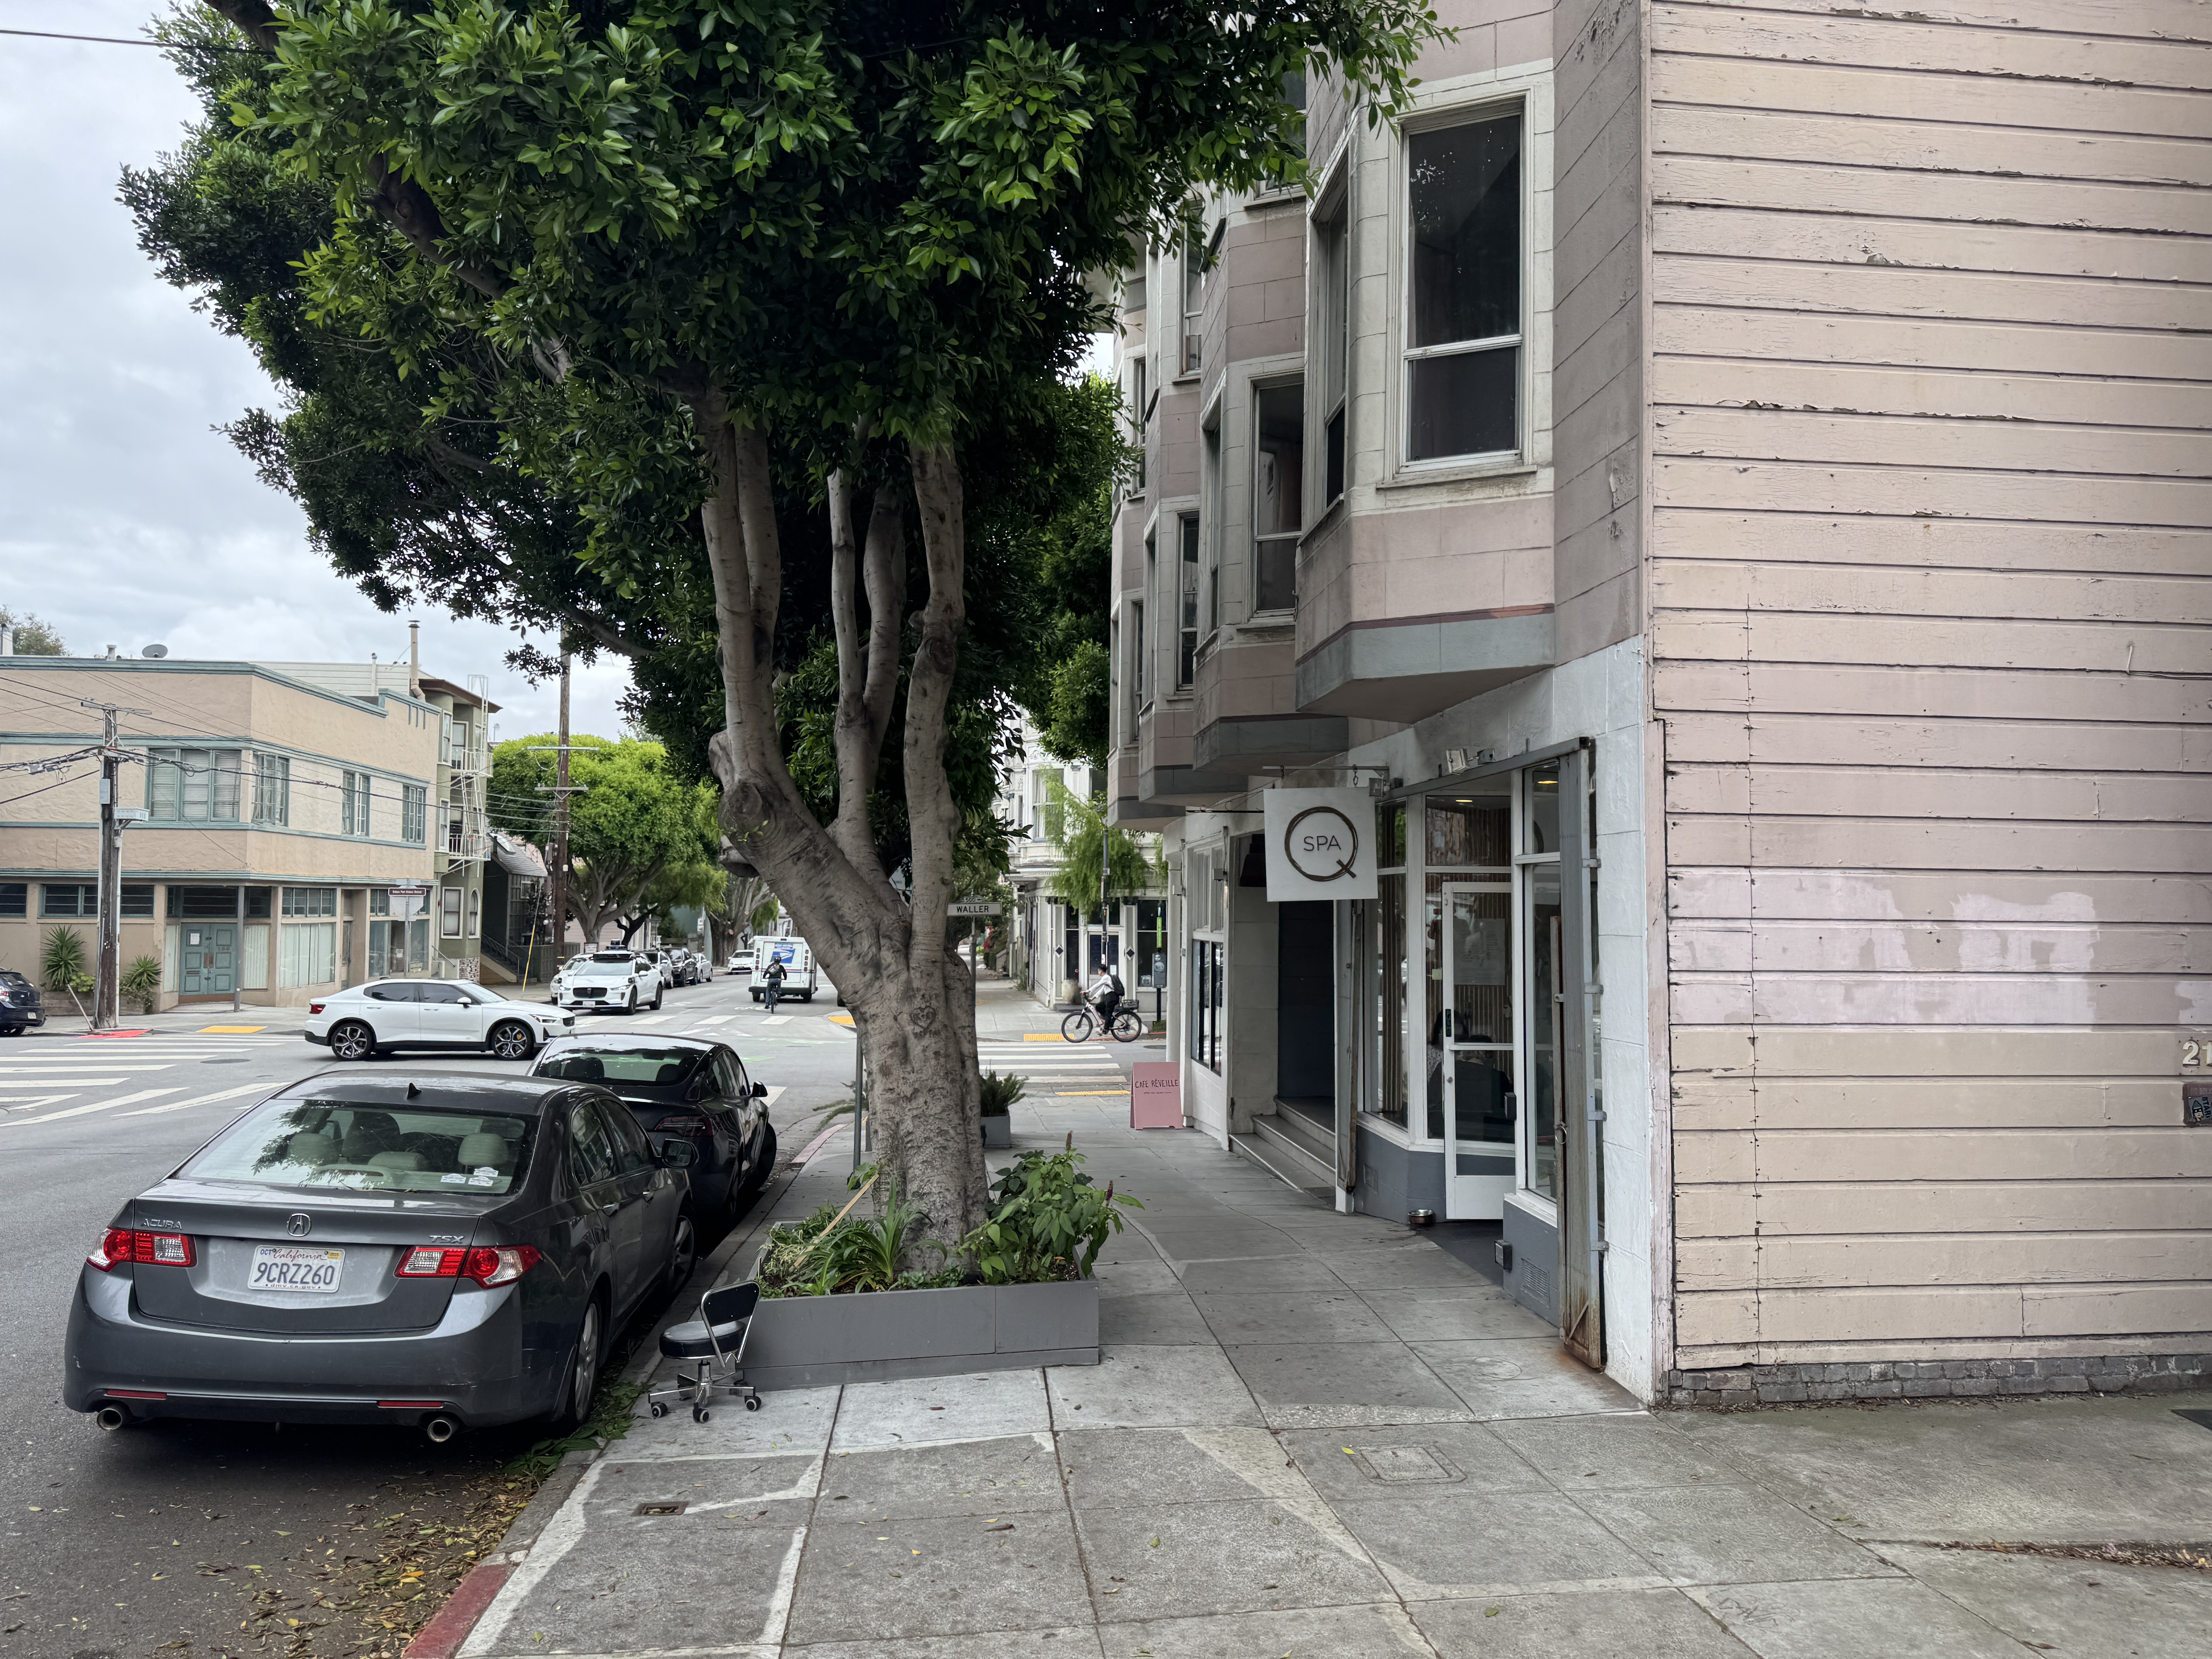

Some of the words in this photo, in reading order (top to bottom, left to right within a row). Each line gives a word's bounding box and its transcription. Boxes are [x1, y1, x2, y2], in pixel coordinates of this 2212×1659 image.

[1284, 806, 1358, 882] Q
[1304, 835, 1341, 851] SPA
[141, 1218, 183, 1230] ACURA
[429, 1235, 464, 1243] TSX
[273, 1249, 327, 1262] California
[254, 1262, 335, 1285] 9CRZ260
